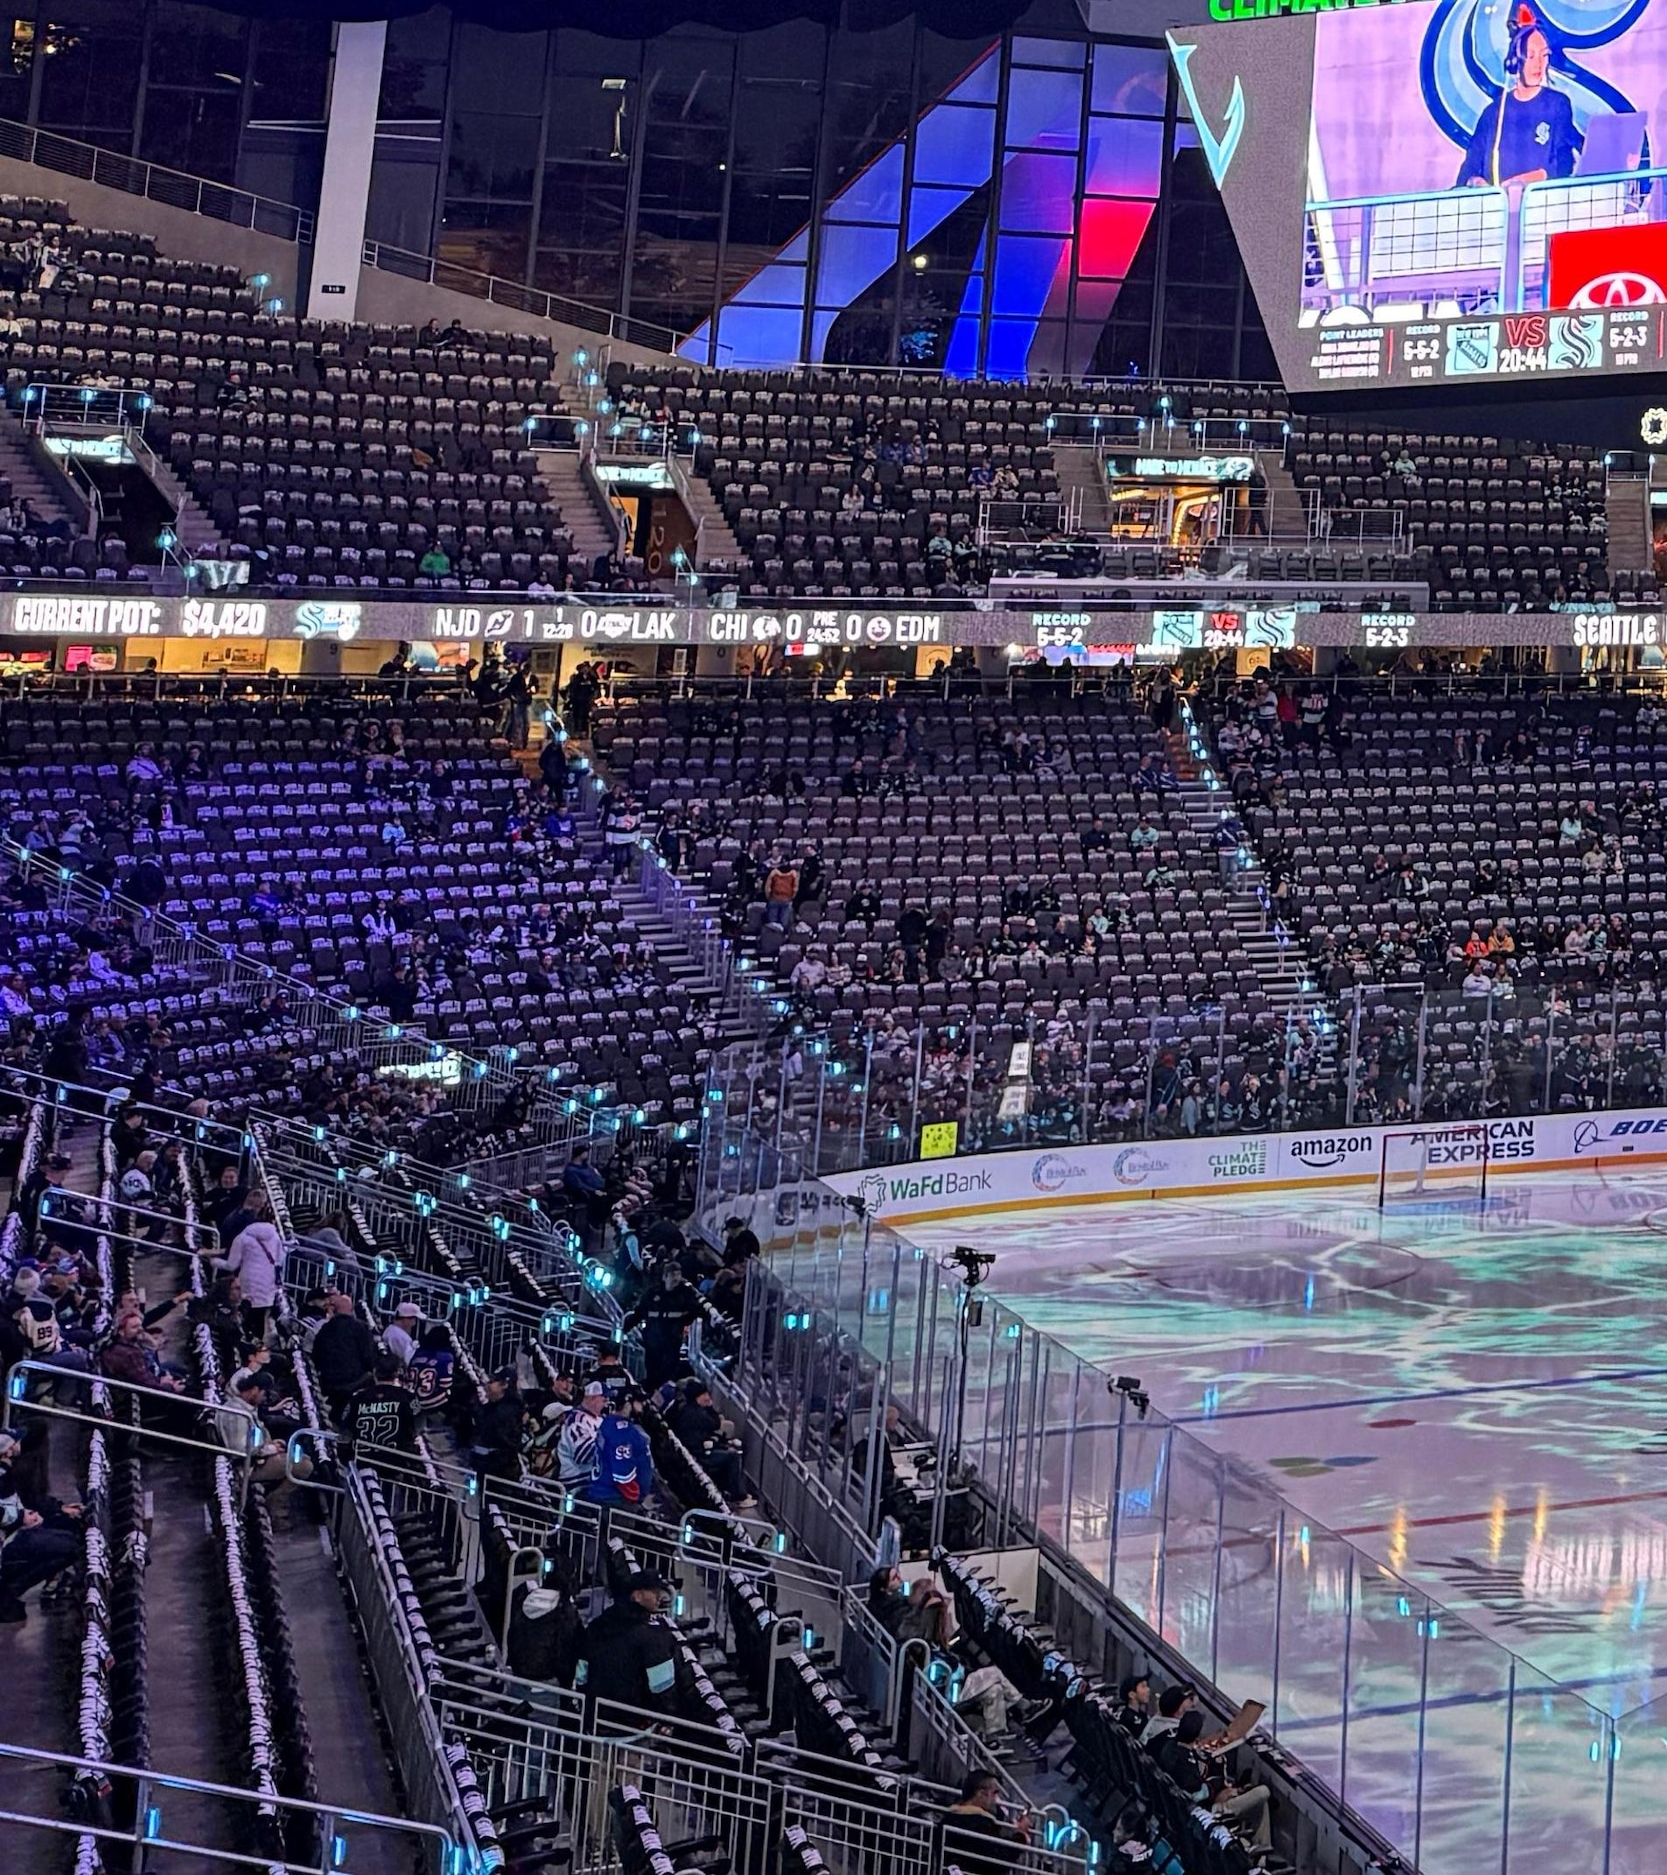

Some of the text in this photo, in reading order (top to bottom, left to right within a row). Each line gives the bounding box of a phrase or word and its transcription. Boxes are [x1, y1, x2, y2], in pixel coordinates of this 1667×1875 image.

[1505, 316, 1546, 348] VS
[1609, 326, 1648, 349] 5-2-3
[1499, 347, 1548, 373] 20:44
[15, 596, 267, 640] CURRENT POT: $4,420
[435, 608, 534, 637] NJD 1
[580, 610, 676, 640] 0 LAK
[710, 614, 802, 641] CHI 0
[812, 611, 838, 628] PRE
[846, 614, 941, 642] 0 EDM
[1032, 613, 1092, 627] RECORD
[1208, 612, 1239, 630] VS
[1361, 614, 1416, 627] RECORD
[1572, 613, 1658, 646] SEATTLE
[1037, 627, 1085, 647] 5-5-2
[1203, 629, 1245, 647] 20:44
[1366, 627, 1409, 647] 5-2-3
[1410, 1119, 1535, 1147] AMERICAN
[1207, 1152, 1267, 1166] CLIMATE
[1240, 1140, 1267, 1153] THE
[1290, 1134, 1372, 1161] amazon
[1427, 1138, 1536, 1166] EXPRESS
[1213, 1163, 1267, 1178] PLEDGE
[890, 1167, 992, 1201] WaFd Bank
[358, 1401, 400, 1416] McNASTY
[356, 1415, 400, 1453] 32
